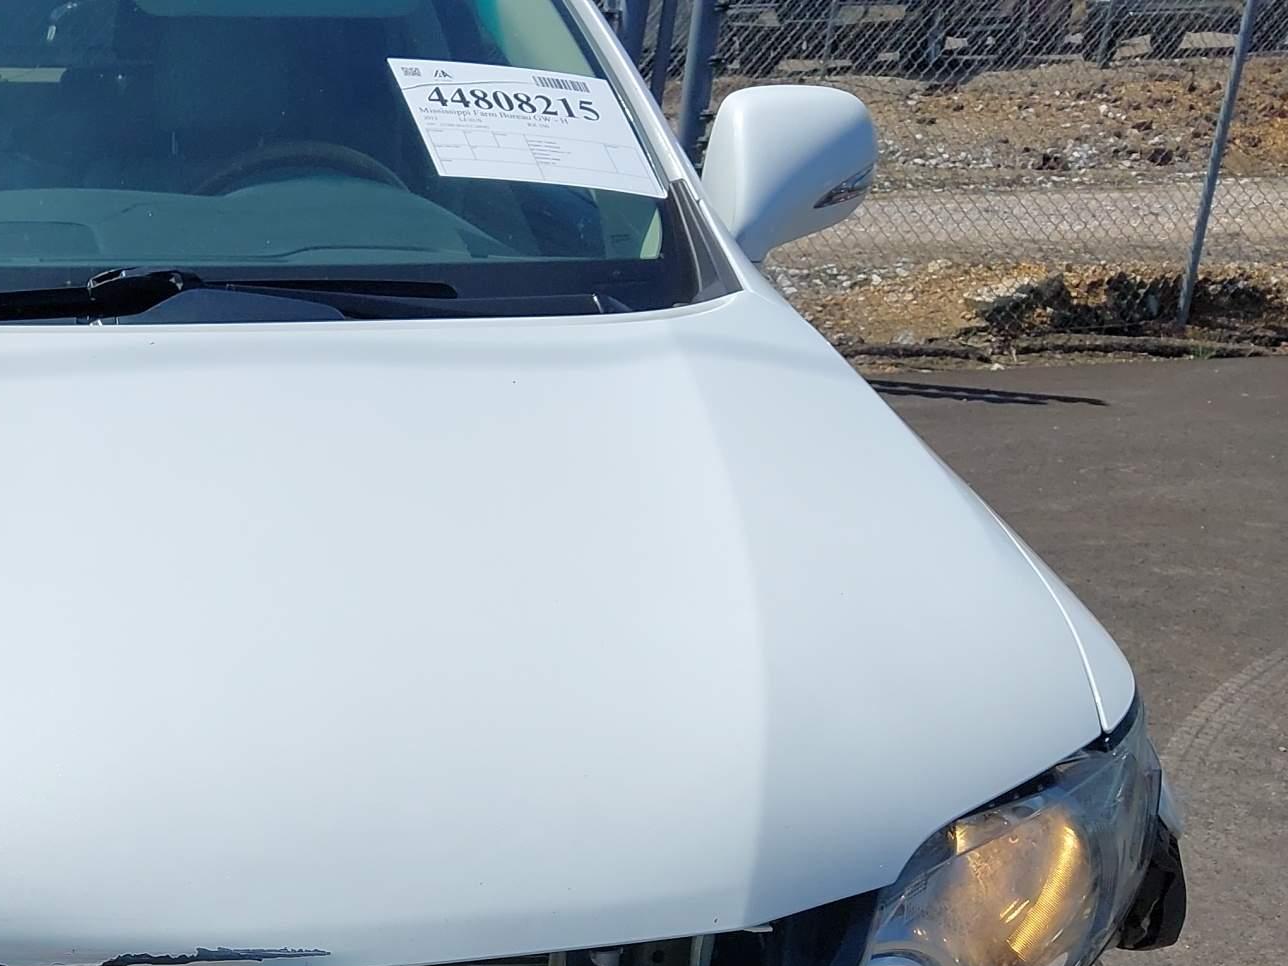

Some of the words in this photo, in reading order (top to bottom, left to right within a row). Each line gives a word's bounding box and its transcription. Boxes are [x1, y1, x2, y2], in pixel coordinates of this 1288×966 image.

[419, 106, 471, 118] Mississippi
[473, 110, 497, 119] Farm
[499, 112, 532, 121] Bureau
[428, 86, 600, 121] 44808215
